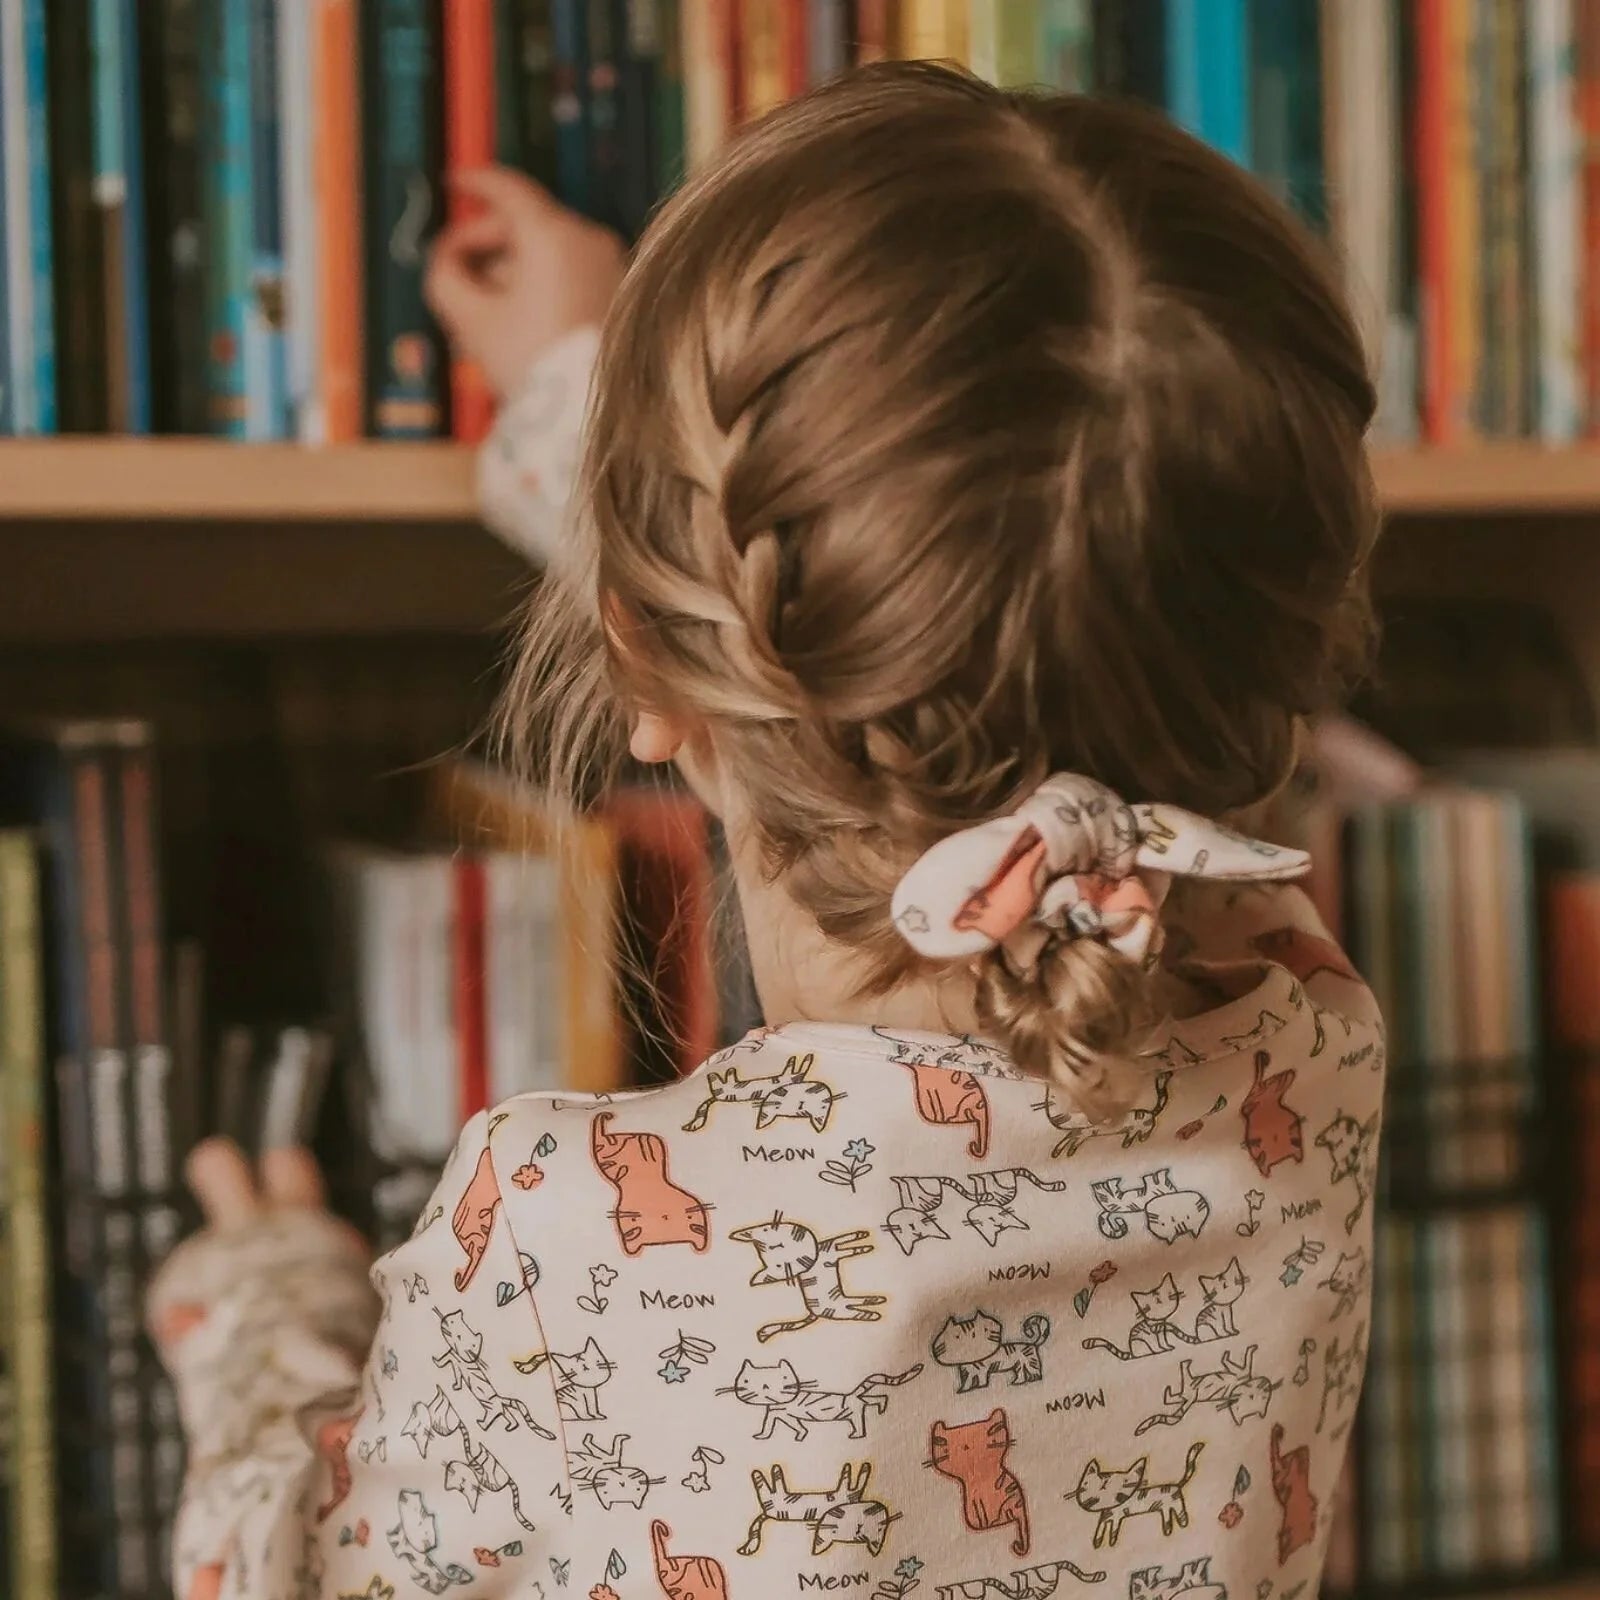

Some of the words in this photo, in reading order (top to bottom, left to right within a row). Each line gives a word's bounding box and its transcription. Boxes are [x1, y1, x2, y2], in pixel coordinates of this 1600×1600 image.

[742, 1145, 815, 1162] Meow
[988, 1261, 1050, 1281] Meow
[640, 1289, 714, 1309] Meow
[1046, 1388, 1105, 1413] Meow
[797, 1572, 869, 1591] Meow
